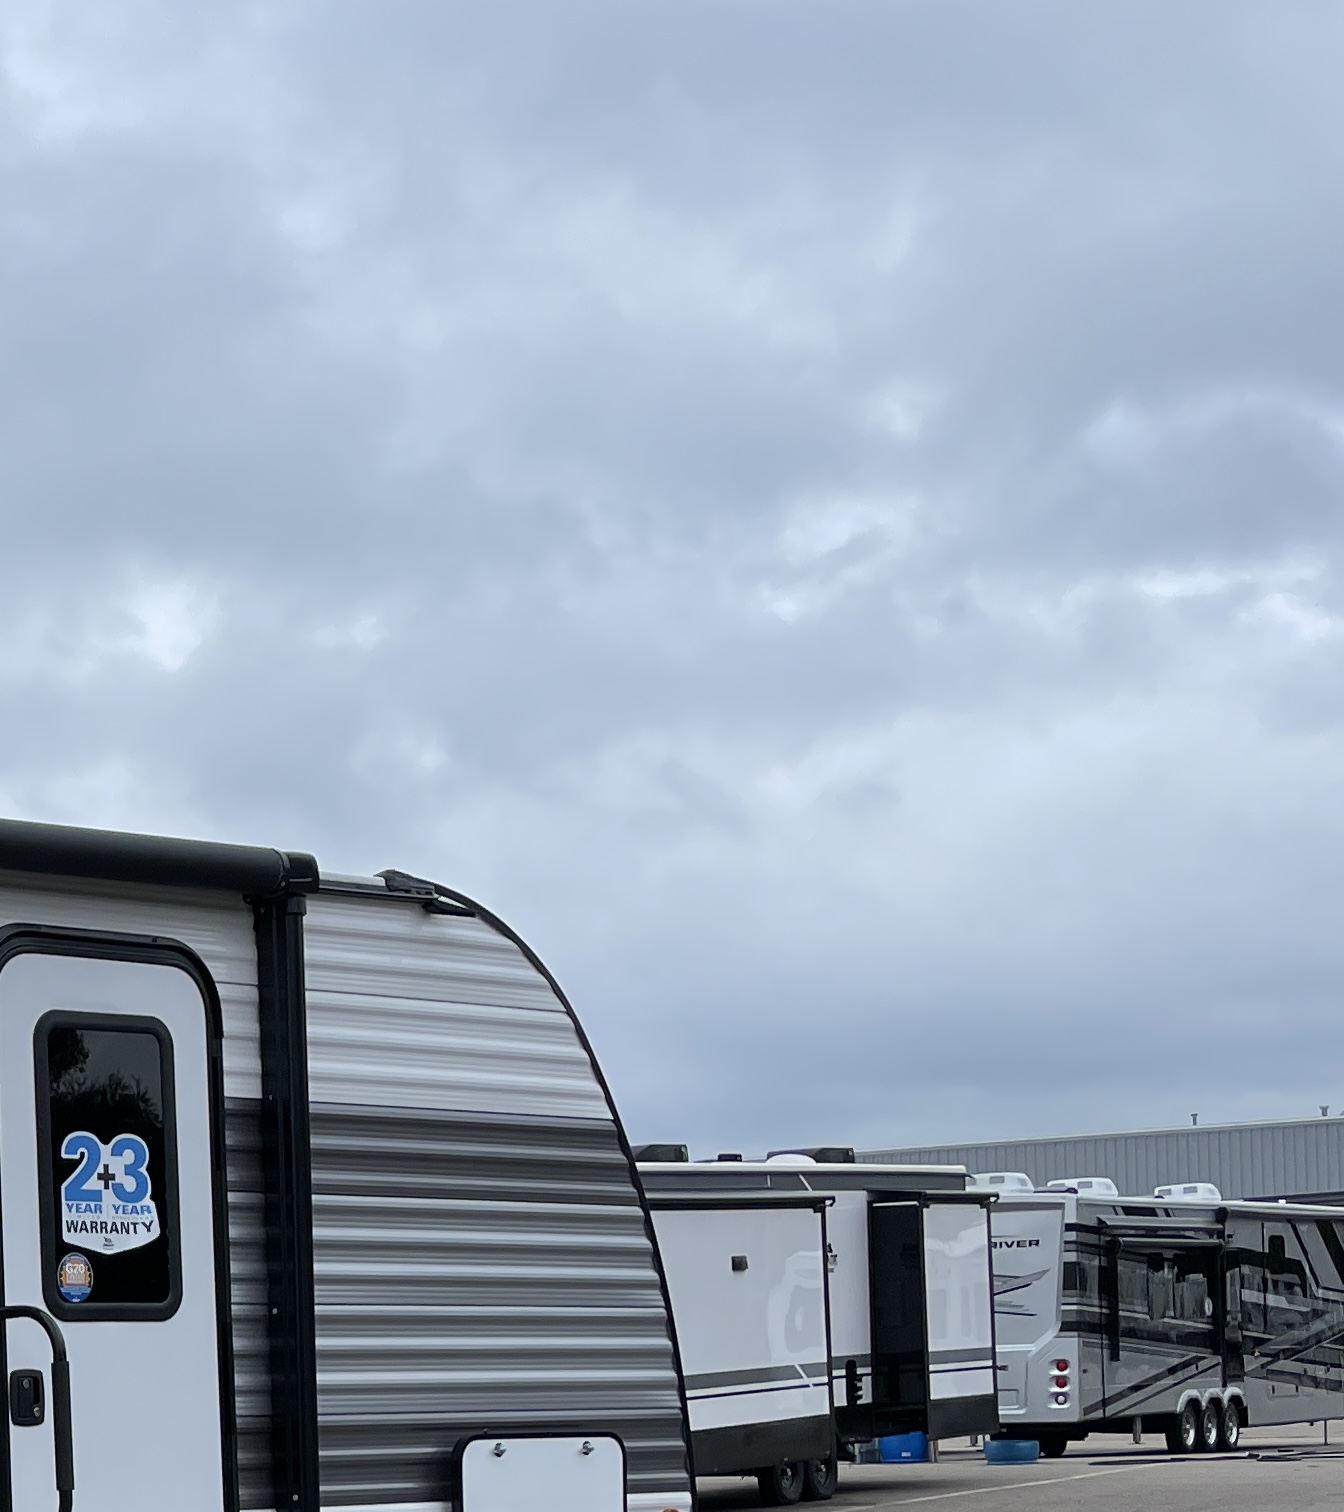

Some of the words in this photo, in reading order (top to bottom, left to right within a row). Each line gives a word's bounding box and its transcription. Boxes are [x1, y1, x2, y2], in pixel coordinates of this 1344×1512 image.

[65, 1203, 103, 1214] YEAR
[112, 1204, 152, 1215] YEAR
[66, 1220, 155, 1235] WARRANTY
